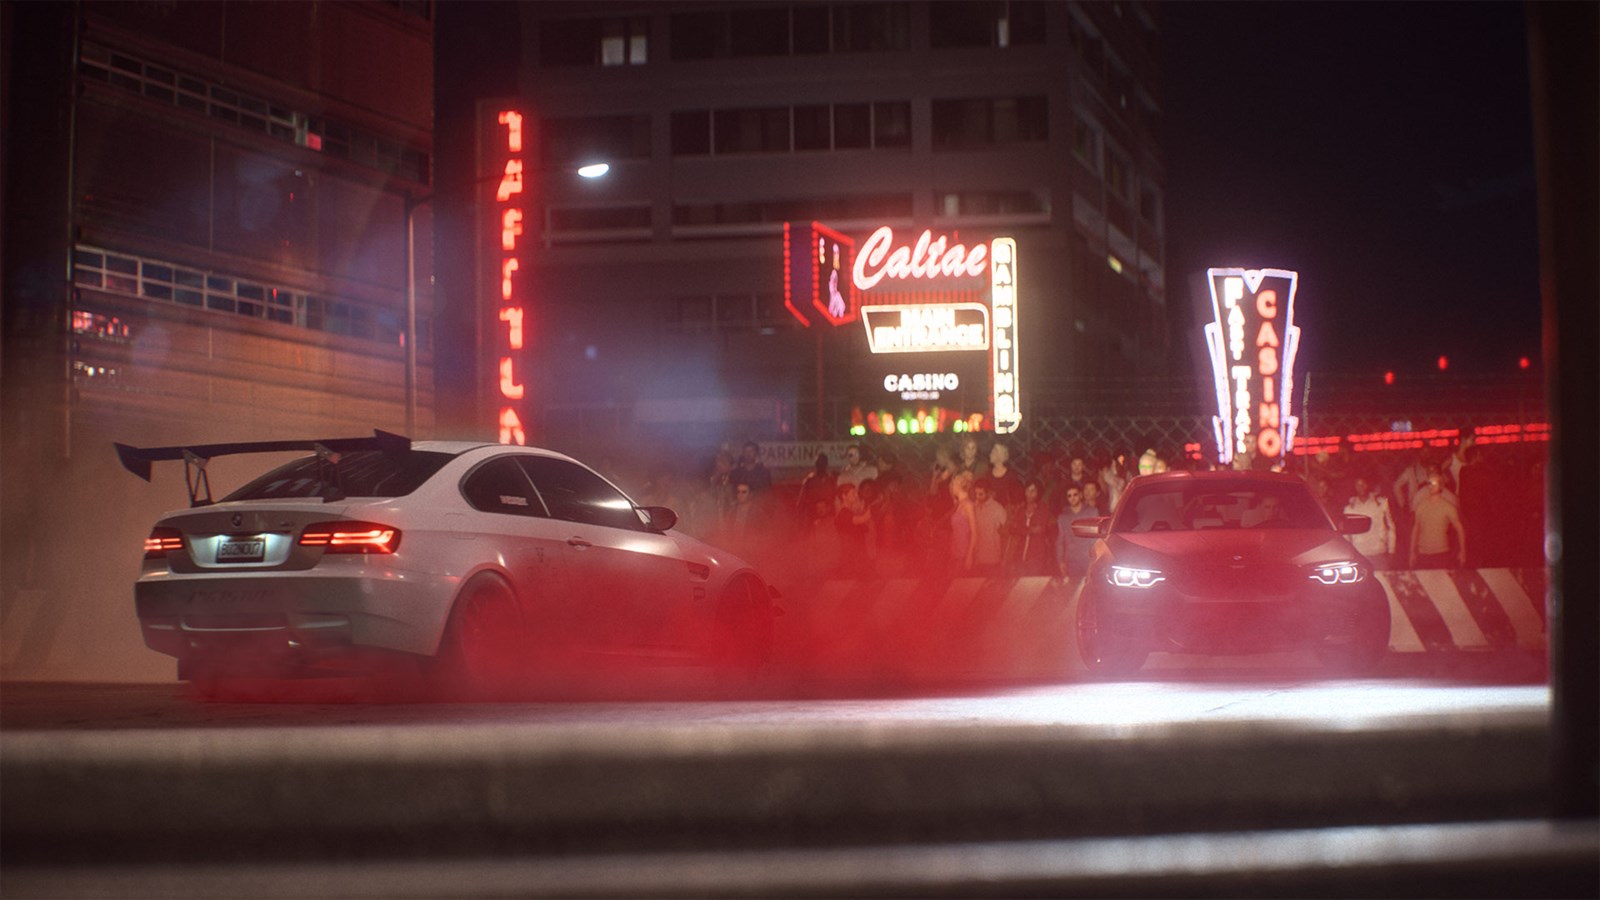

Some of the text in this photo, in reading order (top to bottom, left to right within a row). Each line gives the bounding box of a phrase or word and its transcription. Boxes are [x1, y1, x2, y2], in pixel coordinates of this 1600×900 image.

[900, 307, 956, 327] MAIN
[874, 324, 984, 347] ENTRANCE
[884, 373, 959, 392] CASINO
[1256, 289, 1282, 458] CASINO
